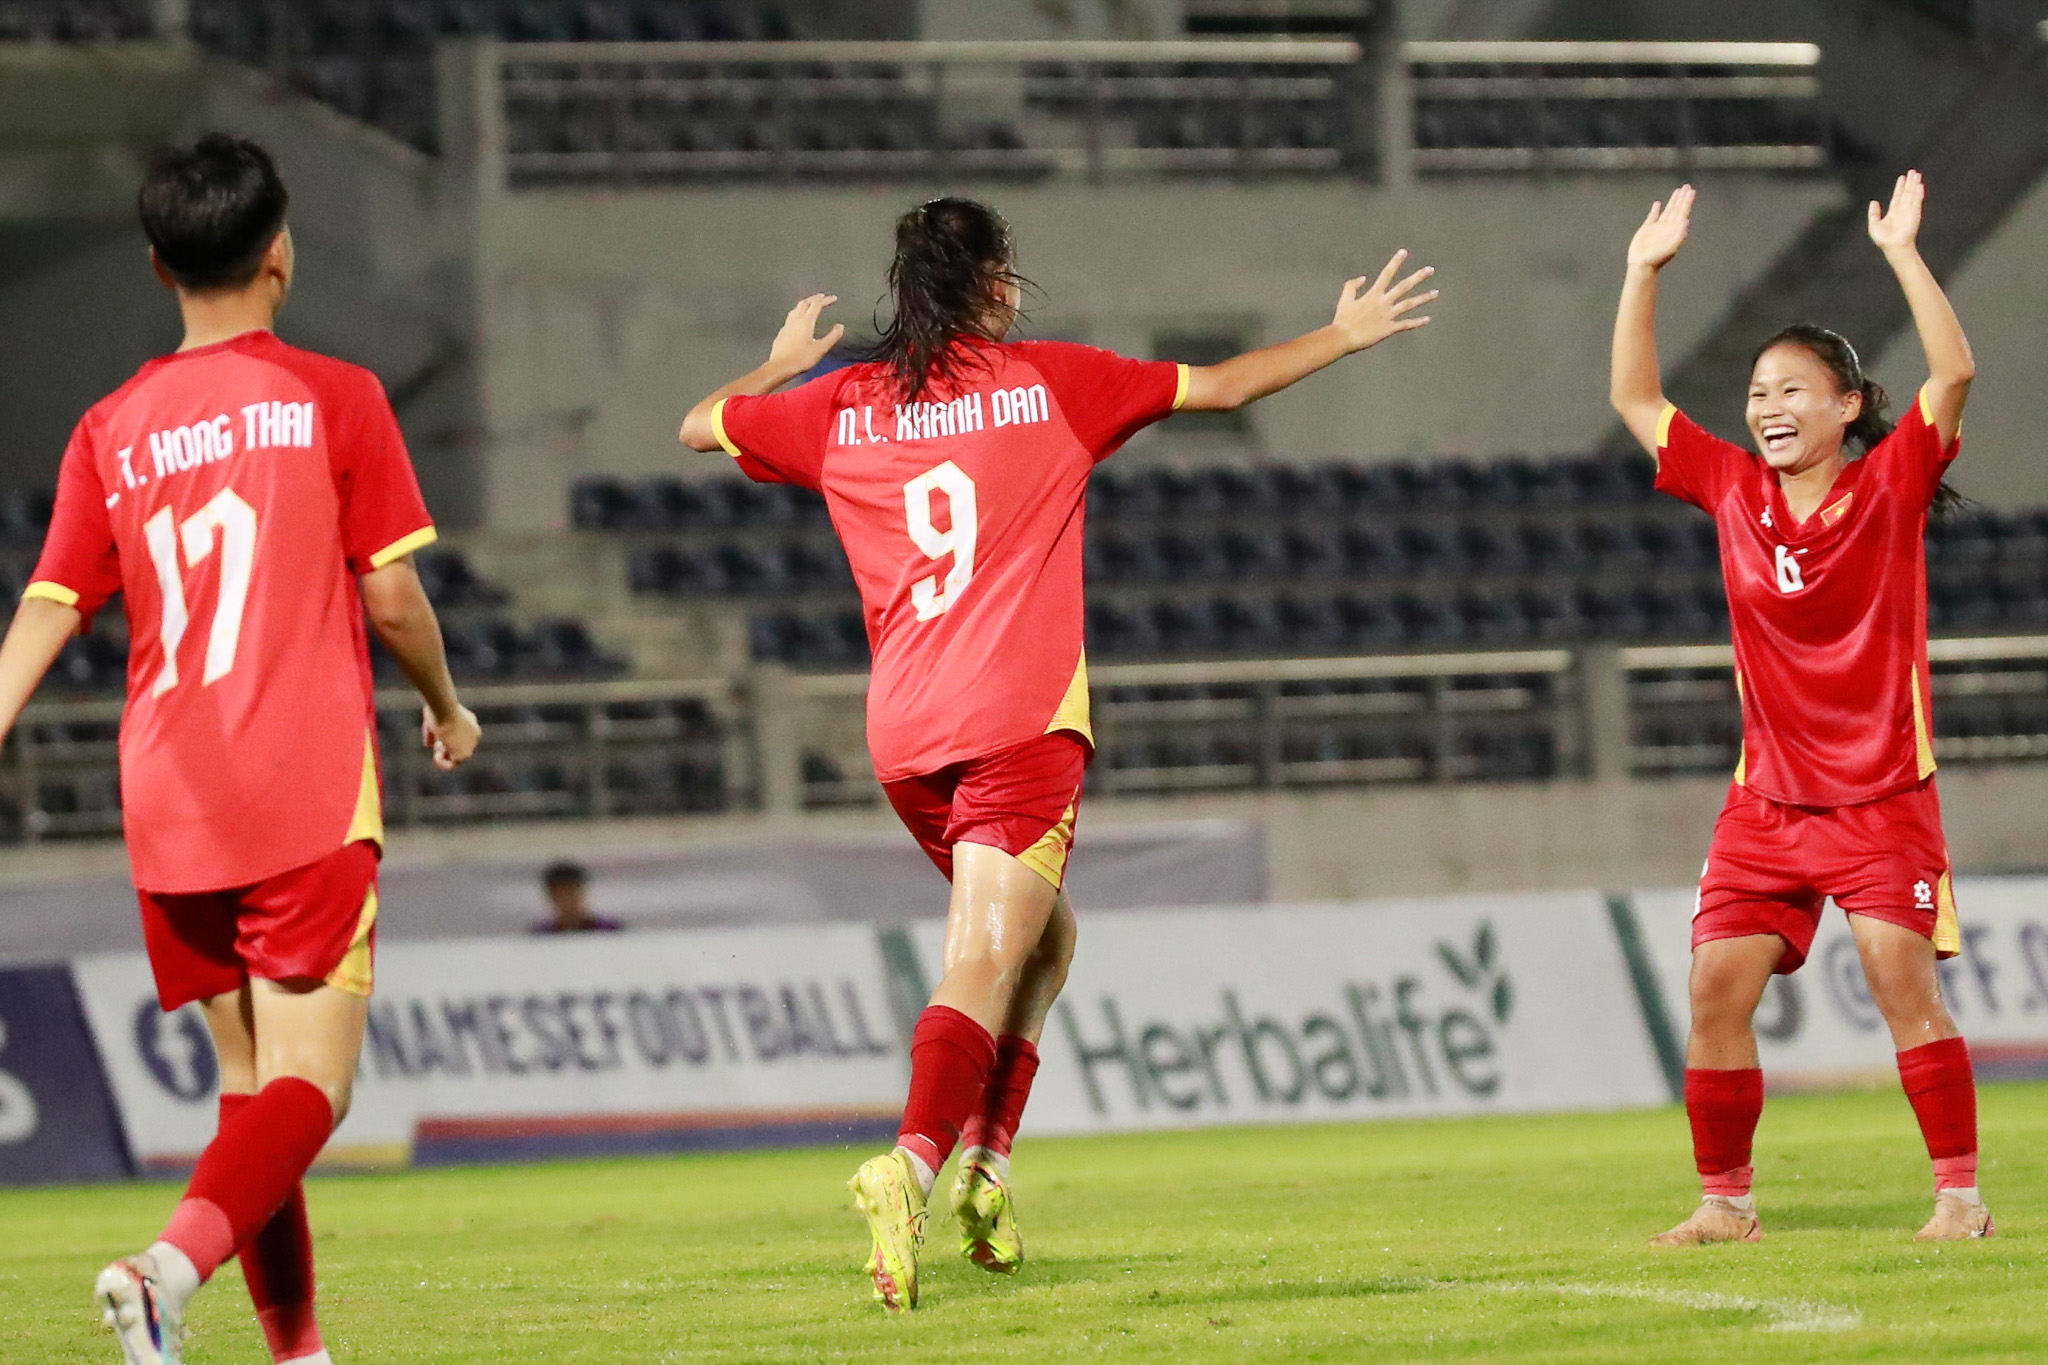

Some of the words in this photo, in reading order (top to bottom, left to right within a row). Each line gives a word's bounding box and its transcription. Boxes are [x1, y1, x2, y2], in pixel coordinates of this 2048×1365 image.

[117, 445, 148, 490] T.
[149, 413, 234, 479] HONG
[240, 400, 314, 451] THAI
[838, 406, 862, 445] N.
[865, 405, 889, 444] L.
[896, 391, 984, 442] KHANH
[990, 383, 1049, 428] DAN
[143, 486, 257, 700] 17
[903, 459, 978, 623] 9
[1775, 544, 1809, 594] 6
[1055, 972, 1502, 1115] Herbalife
